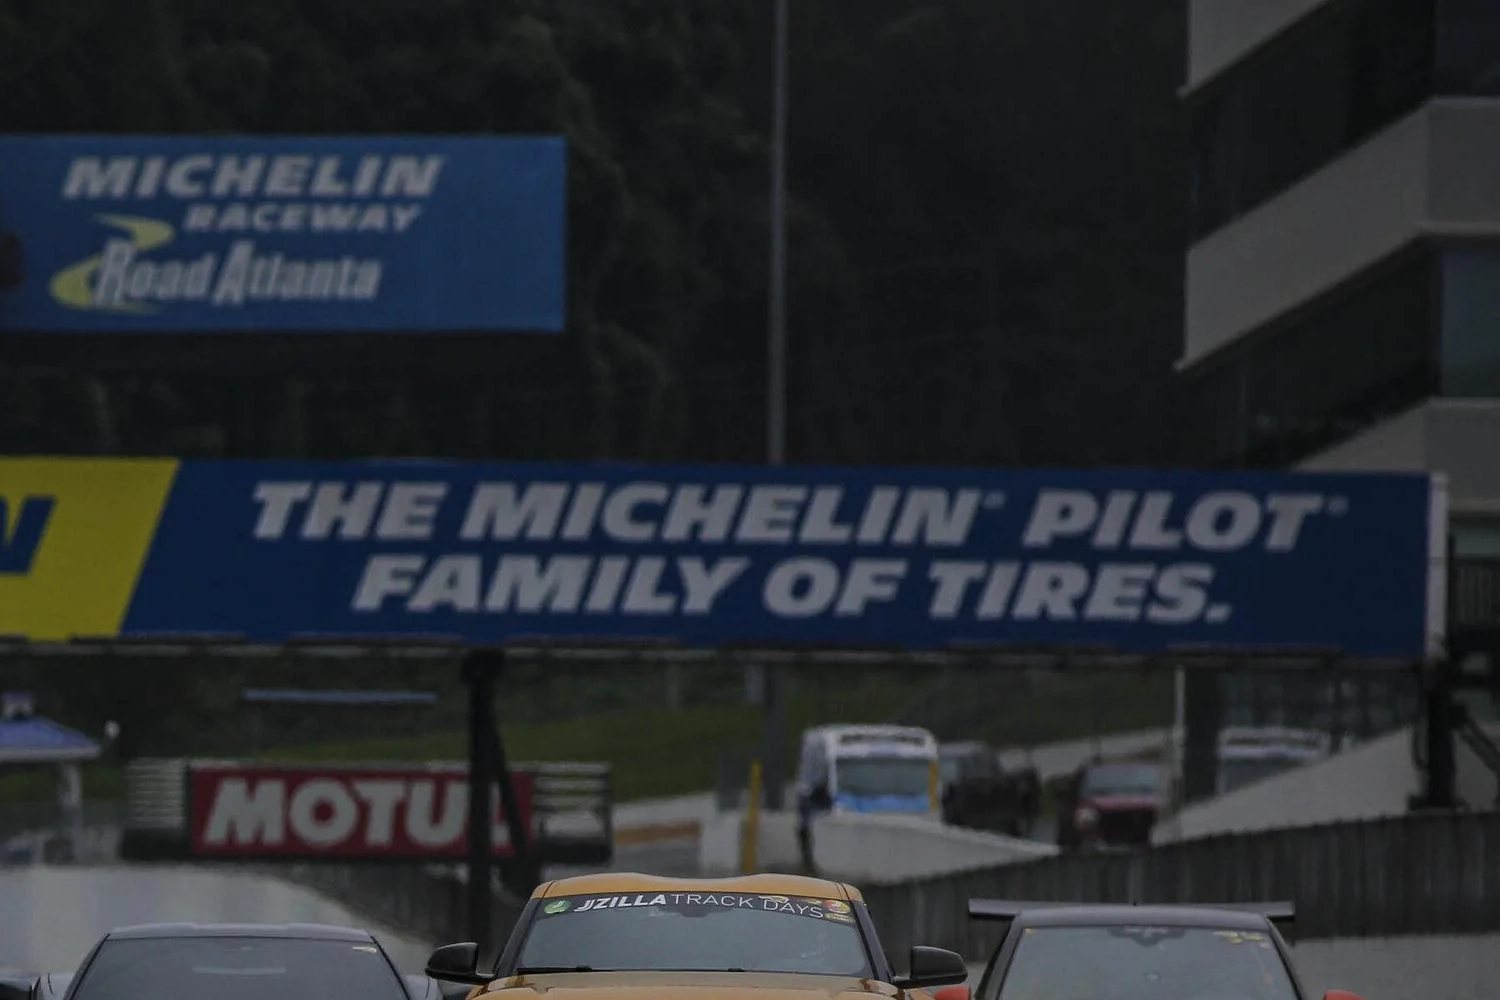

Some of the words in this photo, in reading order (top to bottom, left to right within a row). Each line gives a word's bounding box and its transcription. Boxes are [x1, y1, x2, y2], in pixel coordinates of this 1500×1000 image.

[62, 153, 444, 199] MICHELIN
[183, 204, 422, 233] RACEWAY
[97, 238, 216, 303] Road
[212, 239, 383, 306] Atlanta
[252, 480, 448, 541] THE
[457, 481, 982, 546] MICHELIN
[1020, 487, 1324, 553] PILOT
[351, 553, 750, 616] FAMILY
[761, 555, 908, 619] OF
[927, 557, 1233, 625] TIRES.
[670, 893, 754, 908] TRACK
[763, 898, 824, 919] DAYS
